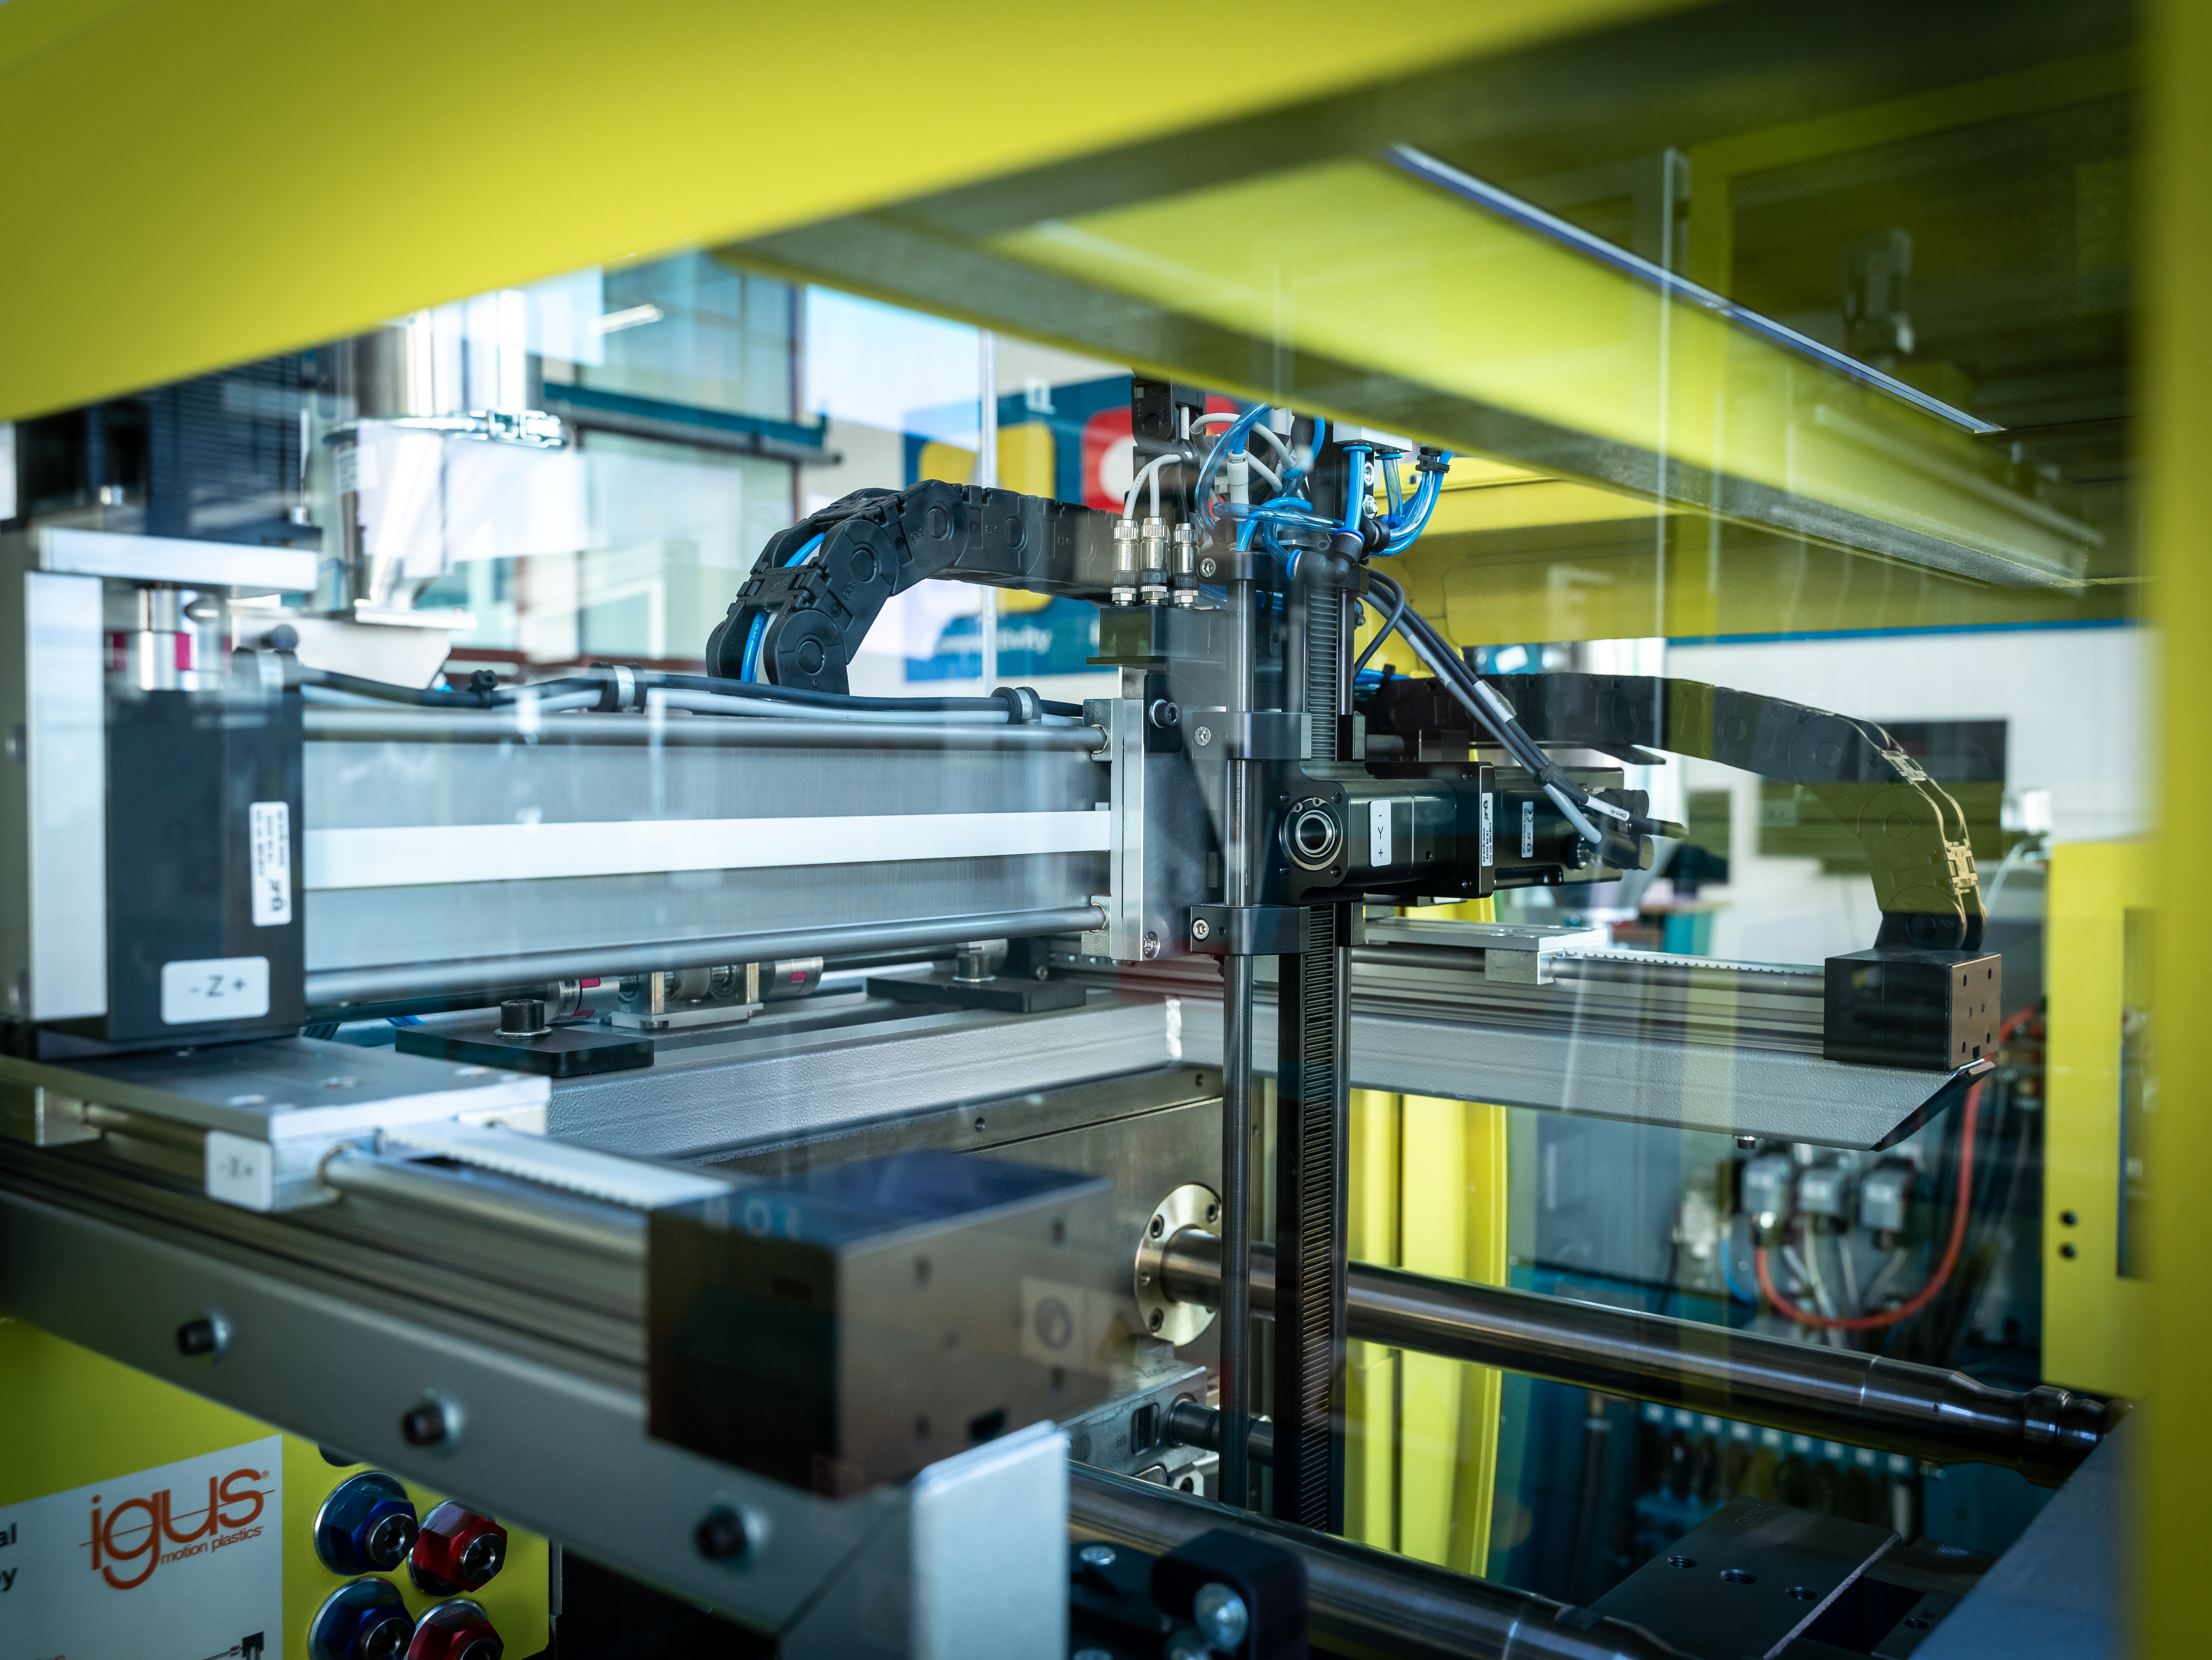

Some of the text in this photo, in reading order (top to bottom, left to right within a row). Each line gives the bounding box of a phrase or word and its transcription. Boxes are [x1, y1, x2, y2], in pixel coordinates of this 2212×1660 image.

[1134, 474, 1142, 490] MADE
[161, 1526, 264, 1565] motion plastics
